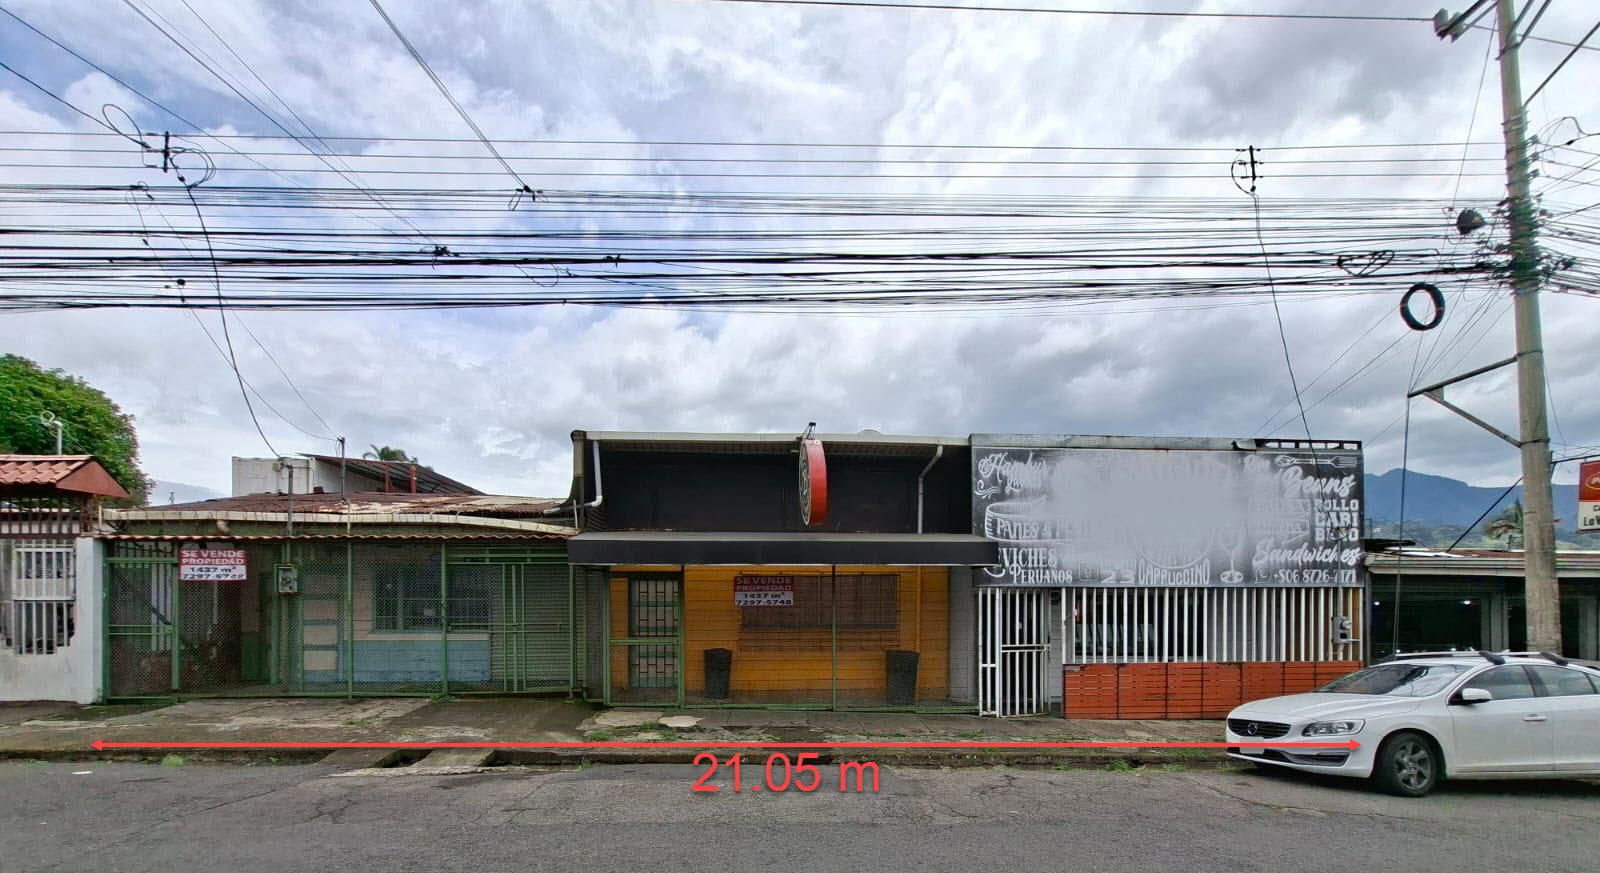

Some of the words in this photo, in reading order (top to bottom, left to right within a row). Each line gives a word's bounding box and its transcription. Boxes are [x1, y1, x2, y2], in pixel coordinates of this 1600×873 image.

[996, 517, 1040, 540] PANES
[182, 550, 198, 558] SE
[200, 550, 244, 558] VENDE
[998, 547, 1058, 567] VICHES
[1251, 538, 1361, 567] Sandwiches
[736, 576, 751, 584] SE
[752, 576, 793, 584] VENDE
[1009, 564, 1073, 584] PERUANOS
